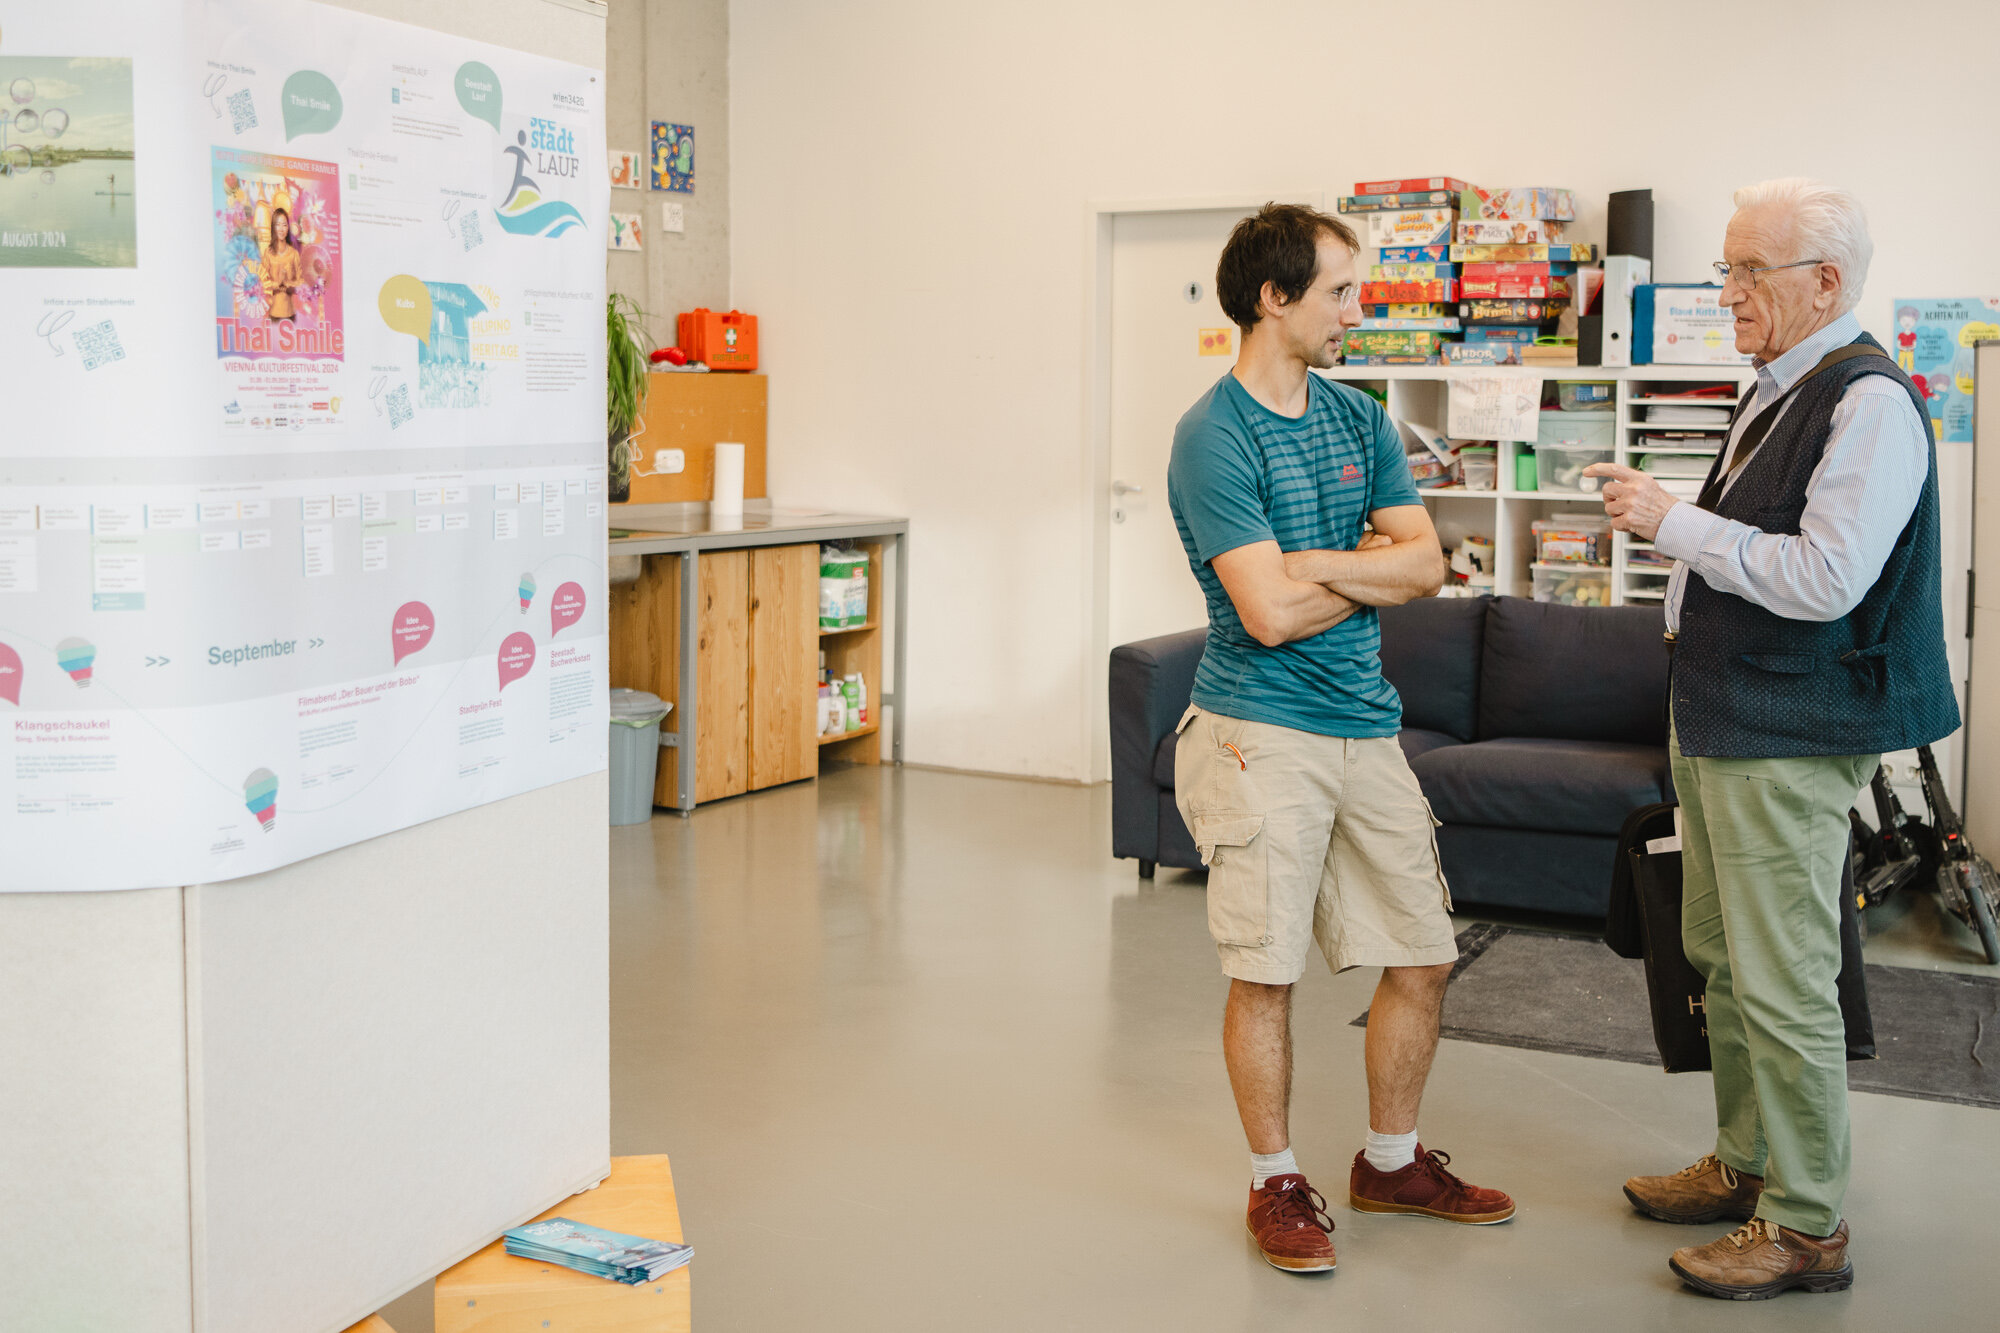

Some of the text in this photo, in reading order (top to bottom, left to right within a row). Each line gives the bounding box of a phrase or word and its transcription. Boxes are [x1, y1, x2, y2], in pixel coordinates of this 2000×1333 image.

[290, 94, 331, 111] Thai Smile
[530, 128, 575, 155] stadt
[537, 152, 579, 178] LAUF
[2, 232, 66, 248] AUGUST 2024
[472, 319, 511, 333] FILIPINO
[216, 317, 345, 354] Thai Smile
[472, 343, 519, 357] HERITAGE
[224, 362, 339, 374] VIENNA KULTURFESTIVAL 2024
[208, 638, 297, 667] September
[550, 647, 576, 659] Seestadt
[550, 654, 591, 668] Buchwerkstatt
[298, 692, 337, 707] Filmabend
[355, 686, 374, 696] Bauer
[375, 682, 387, 691] und
[387, 680, 398, 689] der
[459, 699, 502, 716] Stadtgrün Fest
[15, 719, 111, 732] Klangschaukel
